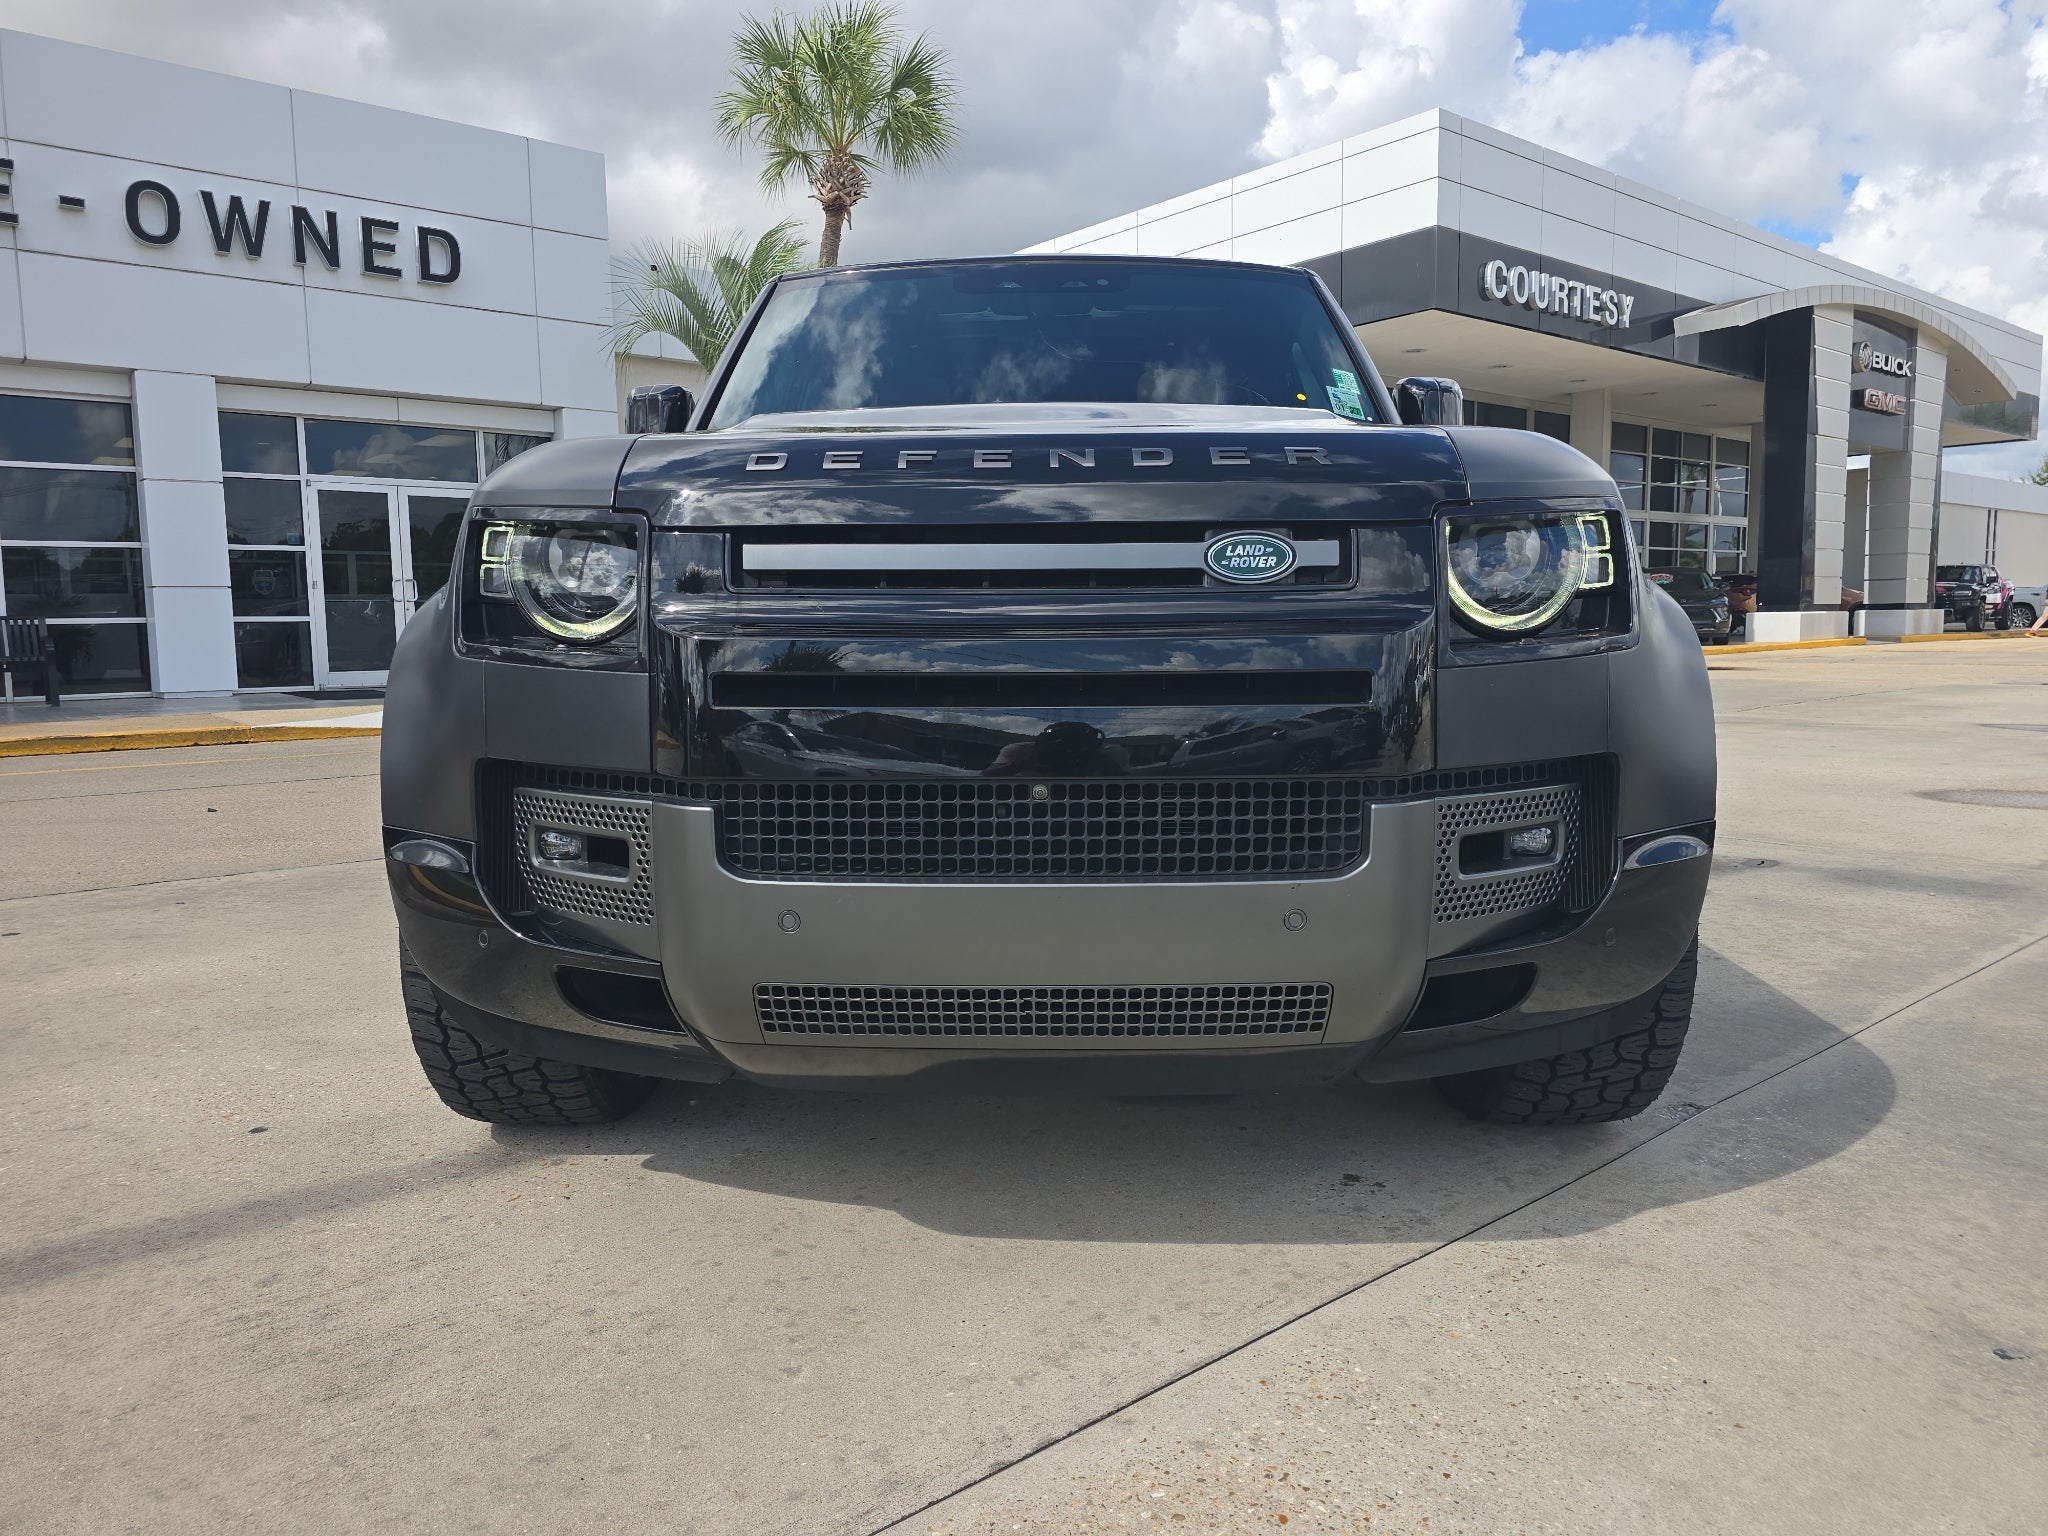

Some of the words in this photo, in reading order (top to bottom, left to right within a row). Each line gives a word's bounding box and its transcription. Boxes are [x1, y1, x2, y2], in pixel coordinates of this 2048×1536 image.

[1486, 260, 1635, 329] COURTESY
[1872, 351, 1912, 377] BUICK
[1864, 388, 1907, 415] GMC
[745, 446, 1333, 471] DEFENDER
[1226, 544, 1265, 556] LAND
[1229, 556, 1277, 568] ROVER
